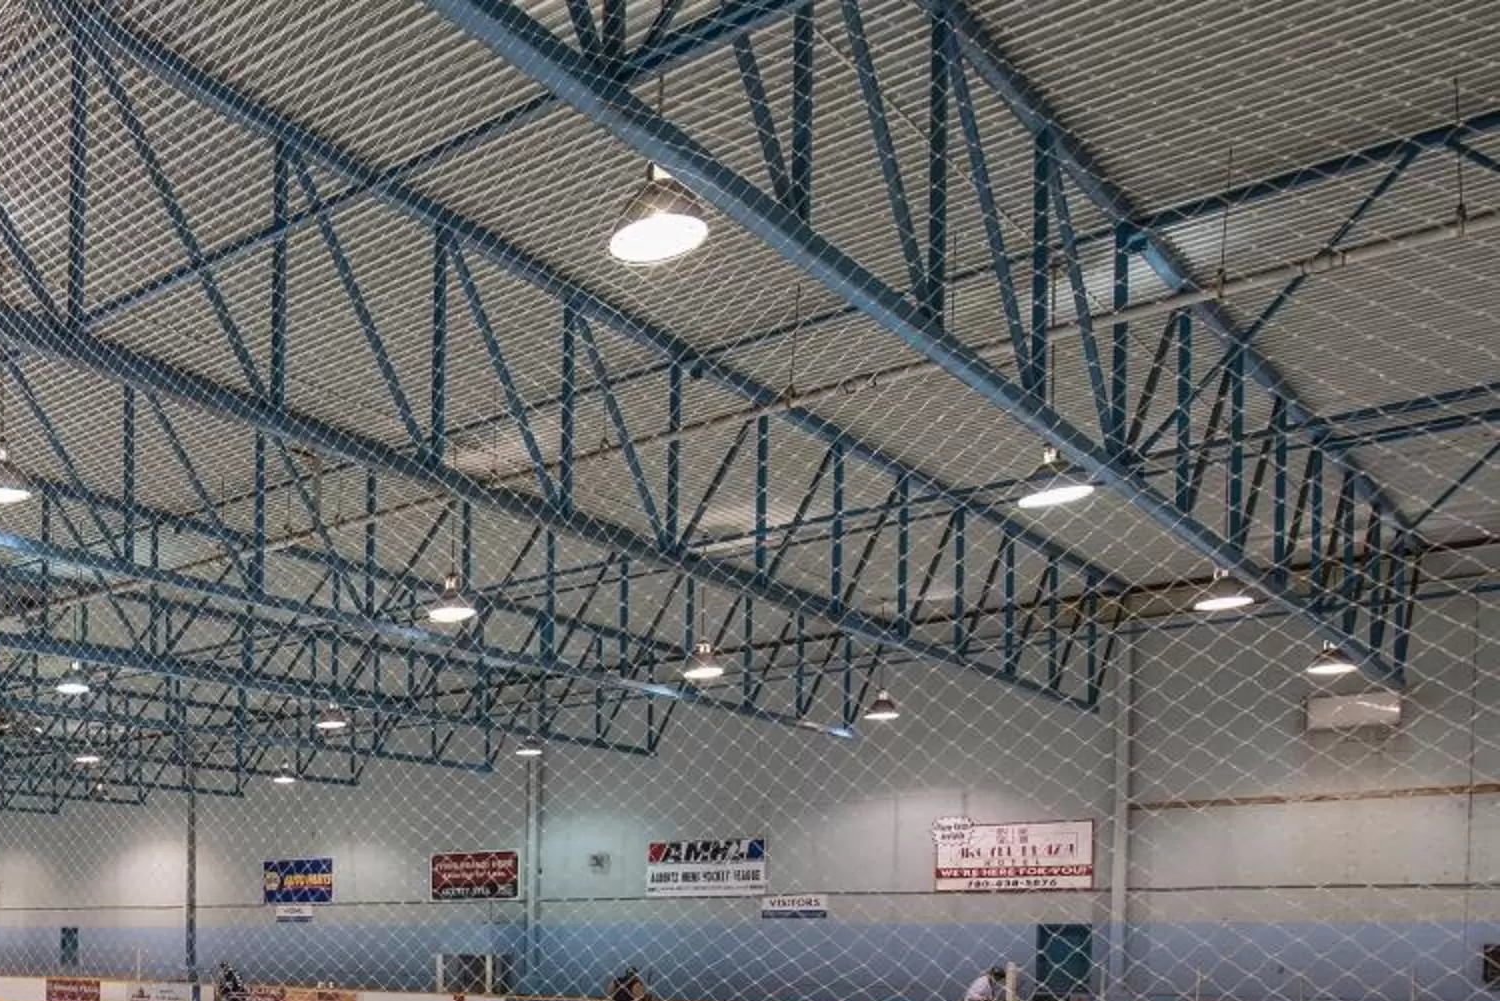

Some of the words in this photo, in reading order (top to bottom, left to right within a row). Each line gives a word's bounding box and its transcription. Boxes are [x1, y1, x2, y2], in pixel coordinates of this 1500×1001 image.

[982, 866, 1014, 877] HERE
[1019, 865, 1046, 876] FOR
[769, 897, 821, 907] VISITORS
